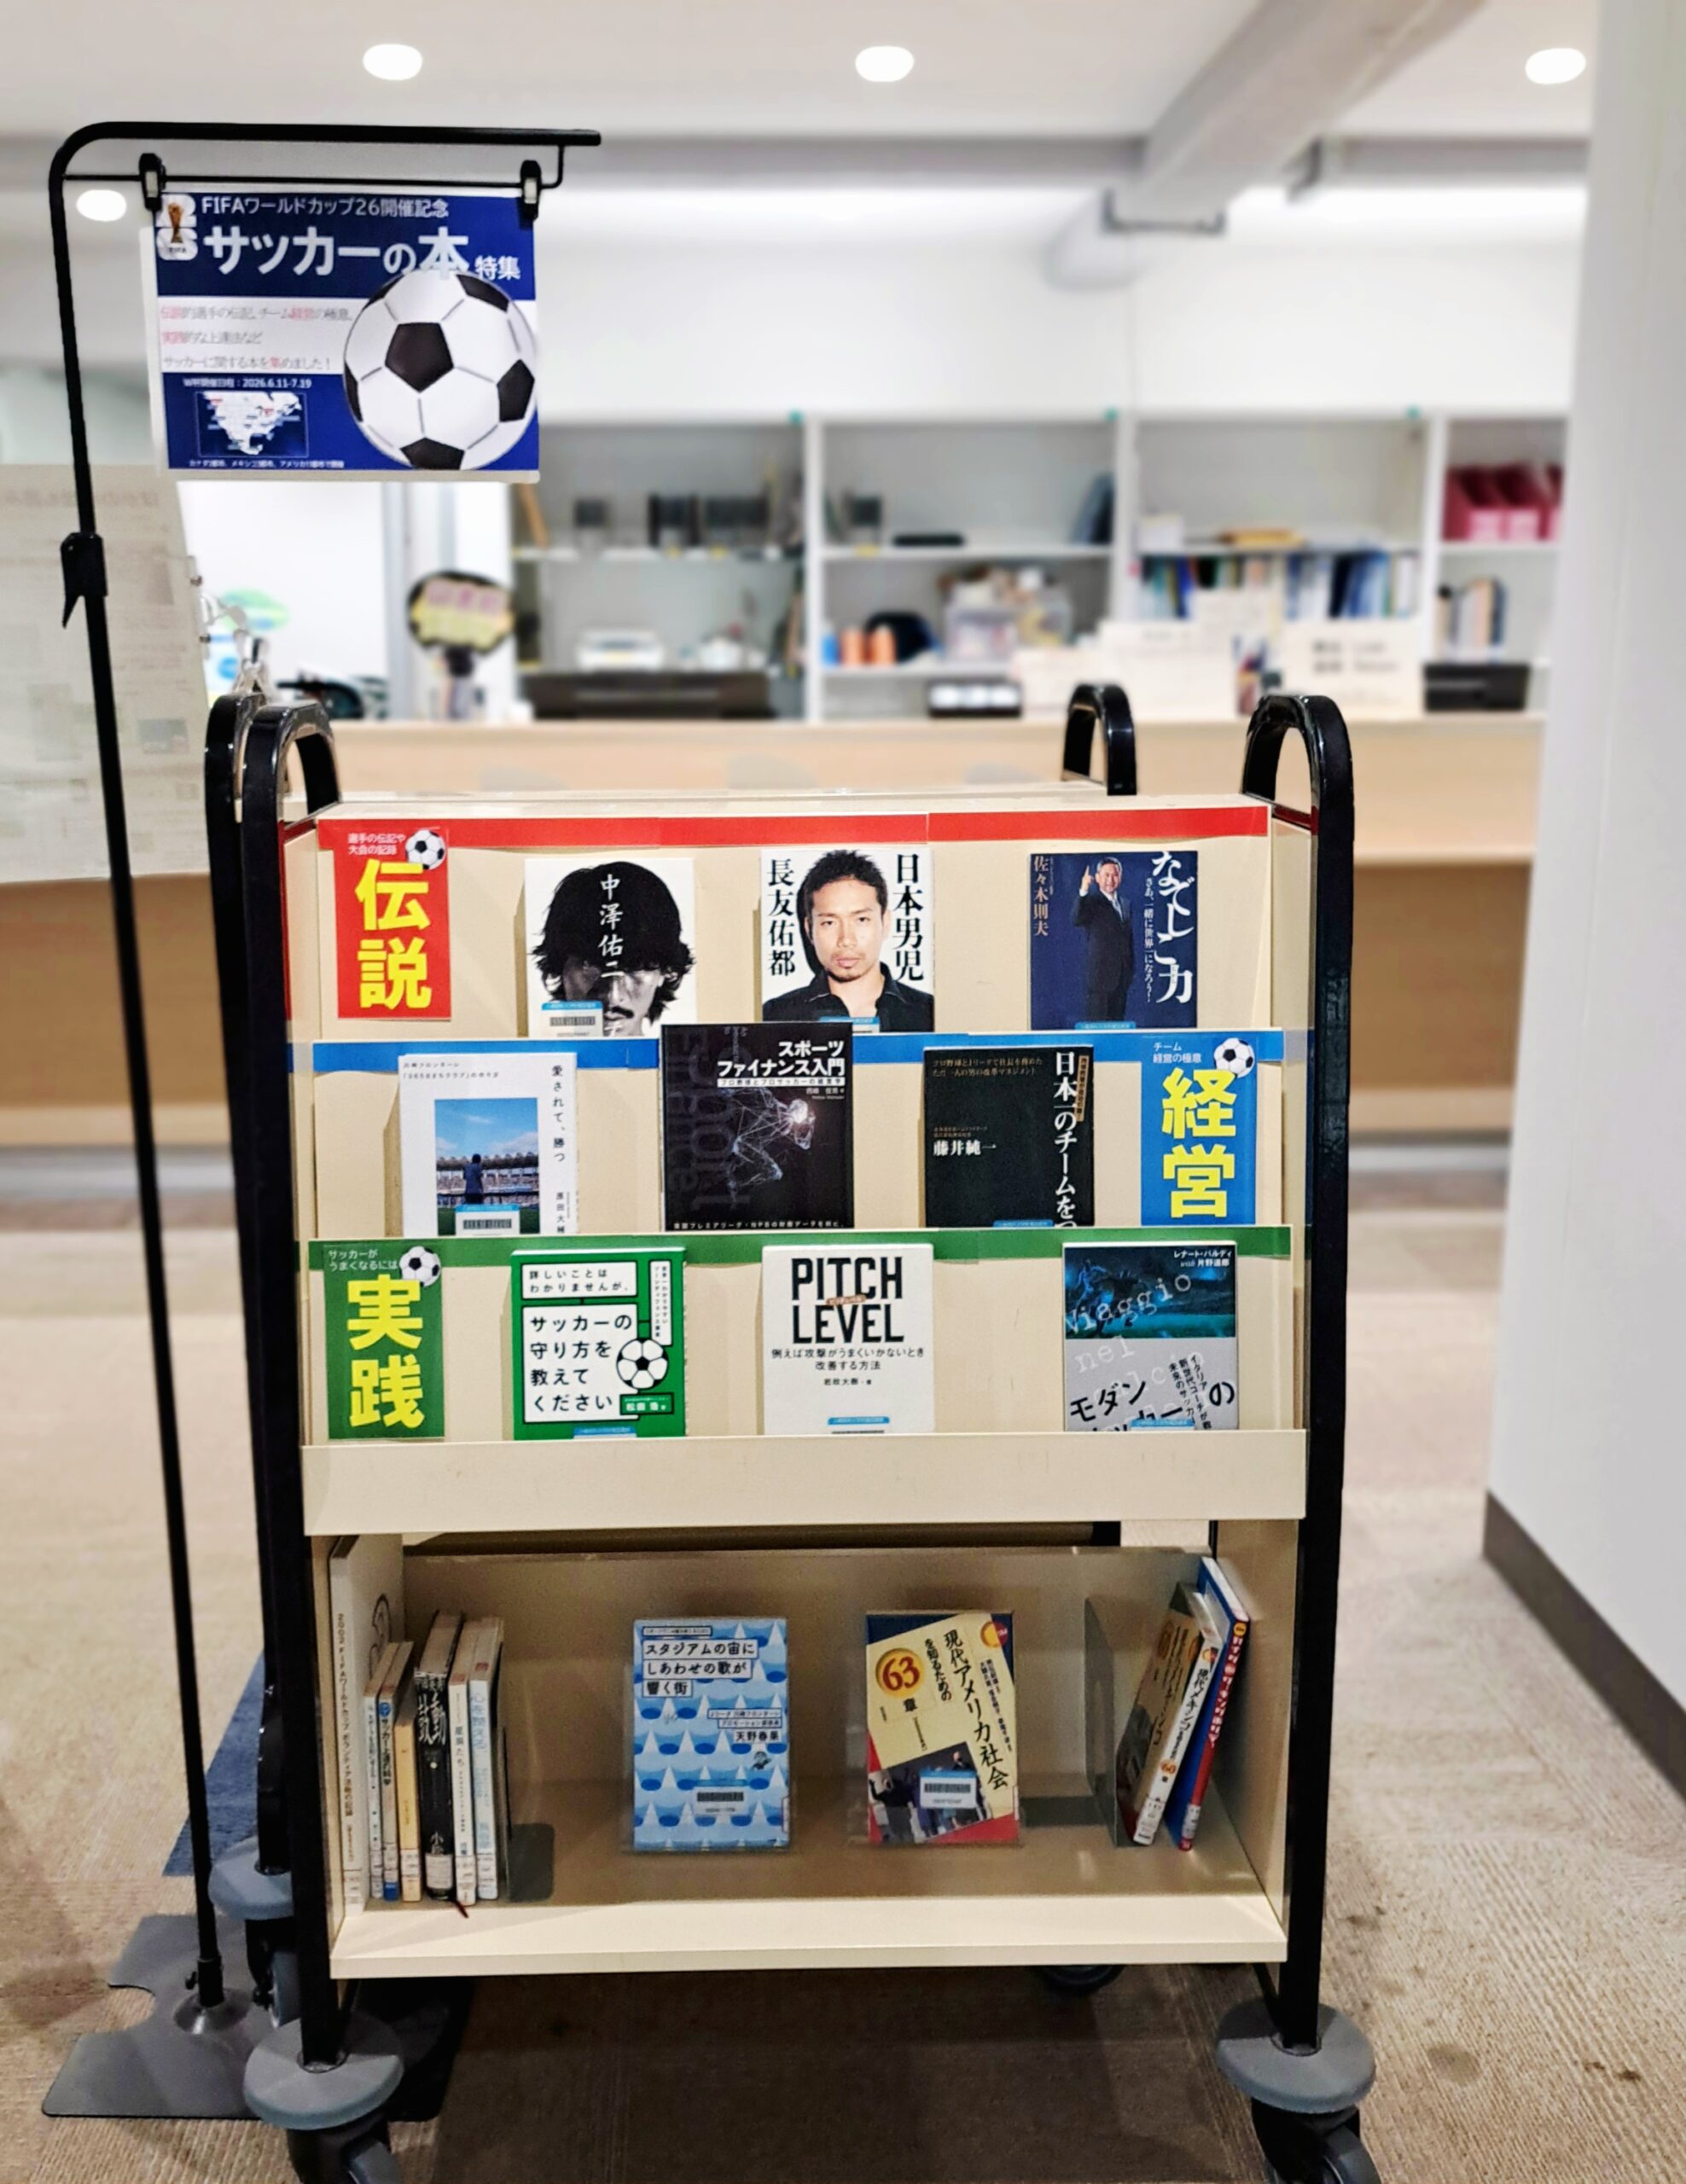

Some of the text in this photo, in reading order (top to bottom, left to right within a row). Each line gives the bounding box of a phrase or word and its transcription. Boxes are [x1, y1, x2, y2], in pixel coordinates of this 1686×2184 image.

[201, 196, 450, 218] FIFAワールドカップ26開催記念
[203, 225, 521, 281] サッカーの本 特集
[347, 833, 406, 845] 選手の伝記や
[348, 845, 397, 856] 大会の記録
[1033, 856, 1049, 936] 佐々木則夫
[598, 874, 624, 978] 中澤佑二
[767, 858, 795, 977] 長友佑都
[892, 854, 924, 982] 日本男児
[355, 858, 433, 1010] 伝説
[1152, 851, 1195, 1003] なでしこ力
[779, 1040, 845, 1057] スポーツ
[1154, 1042, 1182, 1052] チーム
[1153, 1053, 1202, 1063] 経営の極意
[718, 1058, 846, 1077] ファイナンス入門
[552, 1065, 565, 1162] 愛されて、勝つ
[933, 1140, 997, 1156] 藤井純一
[1161, 1066, 1237, 1218] 経営
[328, 1249, 379, 1260] サッカーが
[329, 1260, 398, 1271] うまくなるには
[529, 1269, 608, 1280] 詳しいことは
[530, 1282, 629, 1293] わかりませんが、
[792, 1257, 903, 1300] PITCH
[531, 1315, 632, 1333] サッカーの
[793, 1304, 904, 1345] LEVEL
[347, 1274, 425, 1429] 実践
[531, 1341, 612, 1359] 守り方を
[771, 1348, 924, 1358] 例えば攻撃がうまくいかないとき
[815, 1361, 881, 1371] 改善する方法
[531, 1368, 589, 1386] 教えて
[534, 1394, 613, 1412] ください
[1070, 1381, 1146, 1422] モダン
[645, 1641, 754, 1655] スタジアムの宙に
[648, 1661, 747, 1675] しあわせの歌が
[882, 1655, 920, 1692] 63
[925, 1638, 952, 1702] を知るための
[647, 1681, 688, 1695] 響く街
[903, 1698, 918, 1712] 章
[944, 1629, 1009, 1791] 現代アメリカ社会
